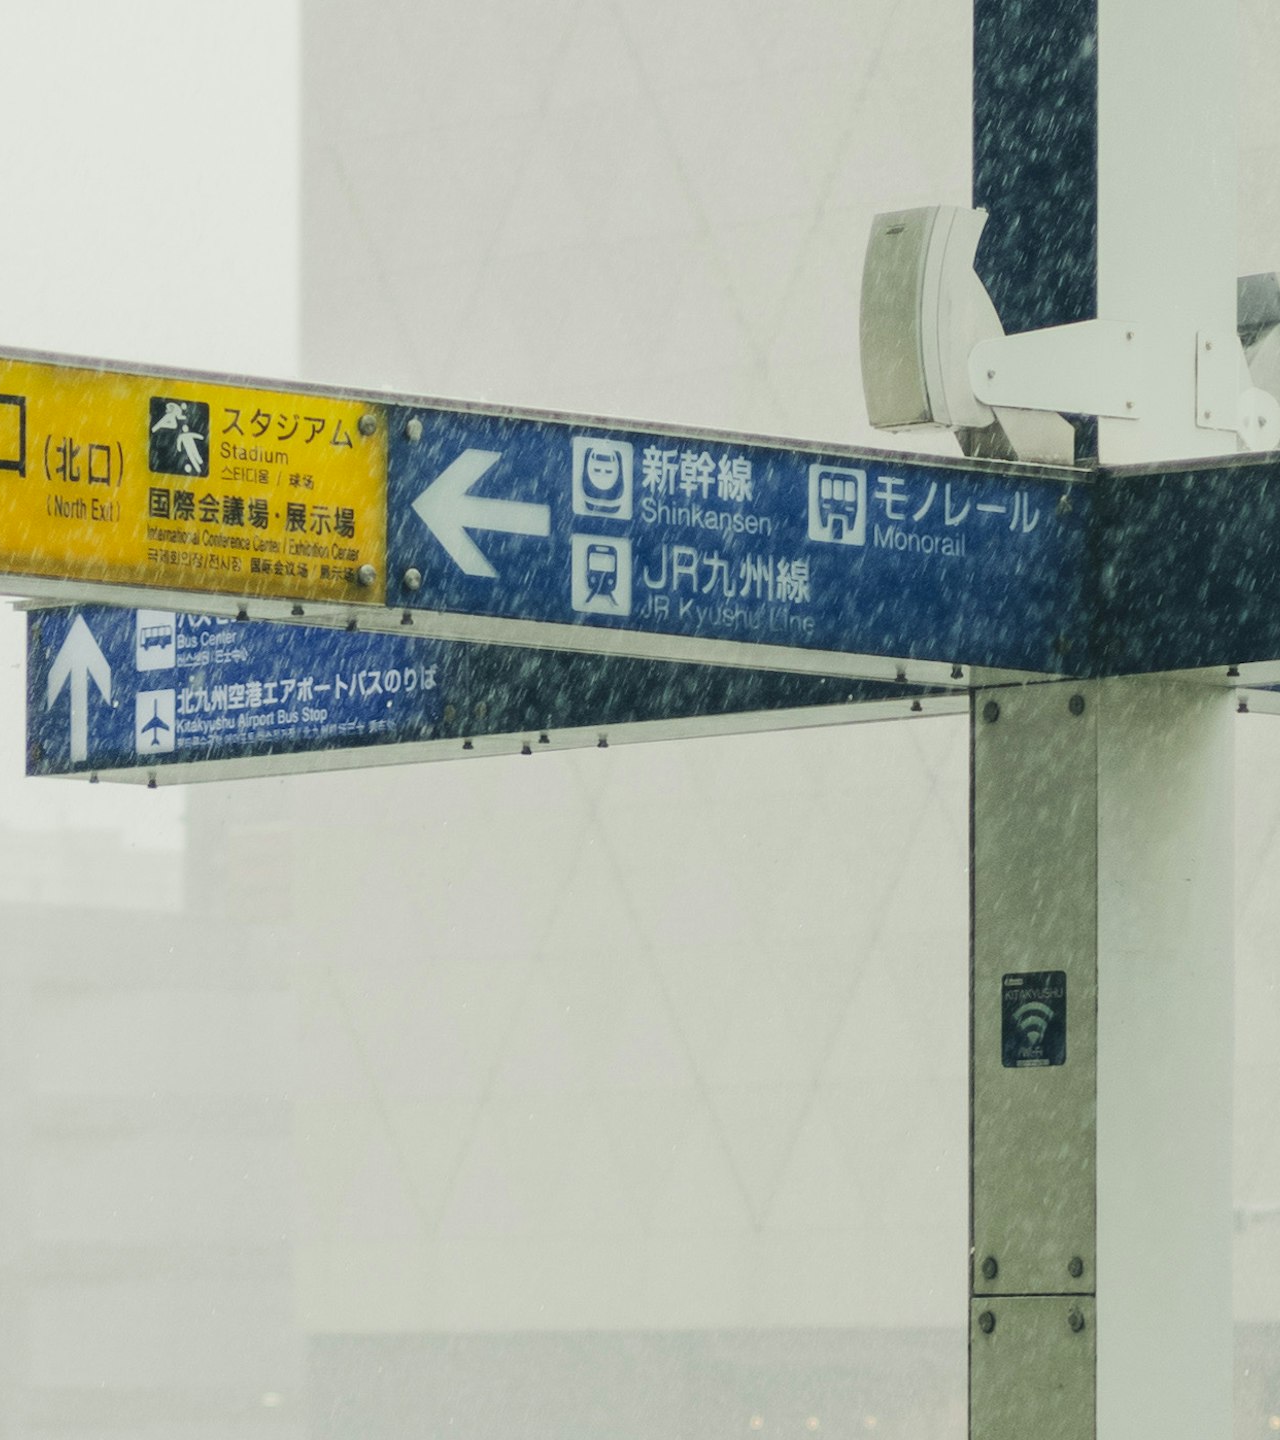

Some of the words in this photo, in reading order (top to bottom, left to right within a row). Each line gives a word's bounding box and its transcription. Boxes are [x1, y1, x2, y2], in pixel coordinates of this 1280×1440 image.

[222, 407, 354, 449] スタジアム
[44, 434, 124, 487] (北口)
[220, 442, 289, 465] Stadium
[641, 444, 753, 503] 新幹線
[640, 497, 771, 536] Shinkansen
[874, 475, 1040, 534] モノレール
[202, 528, 251, 551] Conference
[873, 524, 966, 557] Monorail
[642, 544, 811, 604] JR九州線
[640, 594, 669, 620] JR
[679, 597, 762, 630] Kyushu
[770, 605, 816, 635] Line
[176, 633, 198, 650] Bus
[200, 631, 237, 647] Center
[176, 717, 236, 735] Kitakyushu
[238, 711, 275, 730] Airport
[277, 710, 299, 724] Bus
[301, 706, 328, 724] Stop
